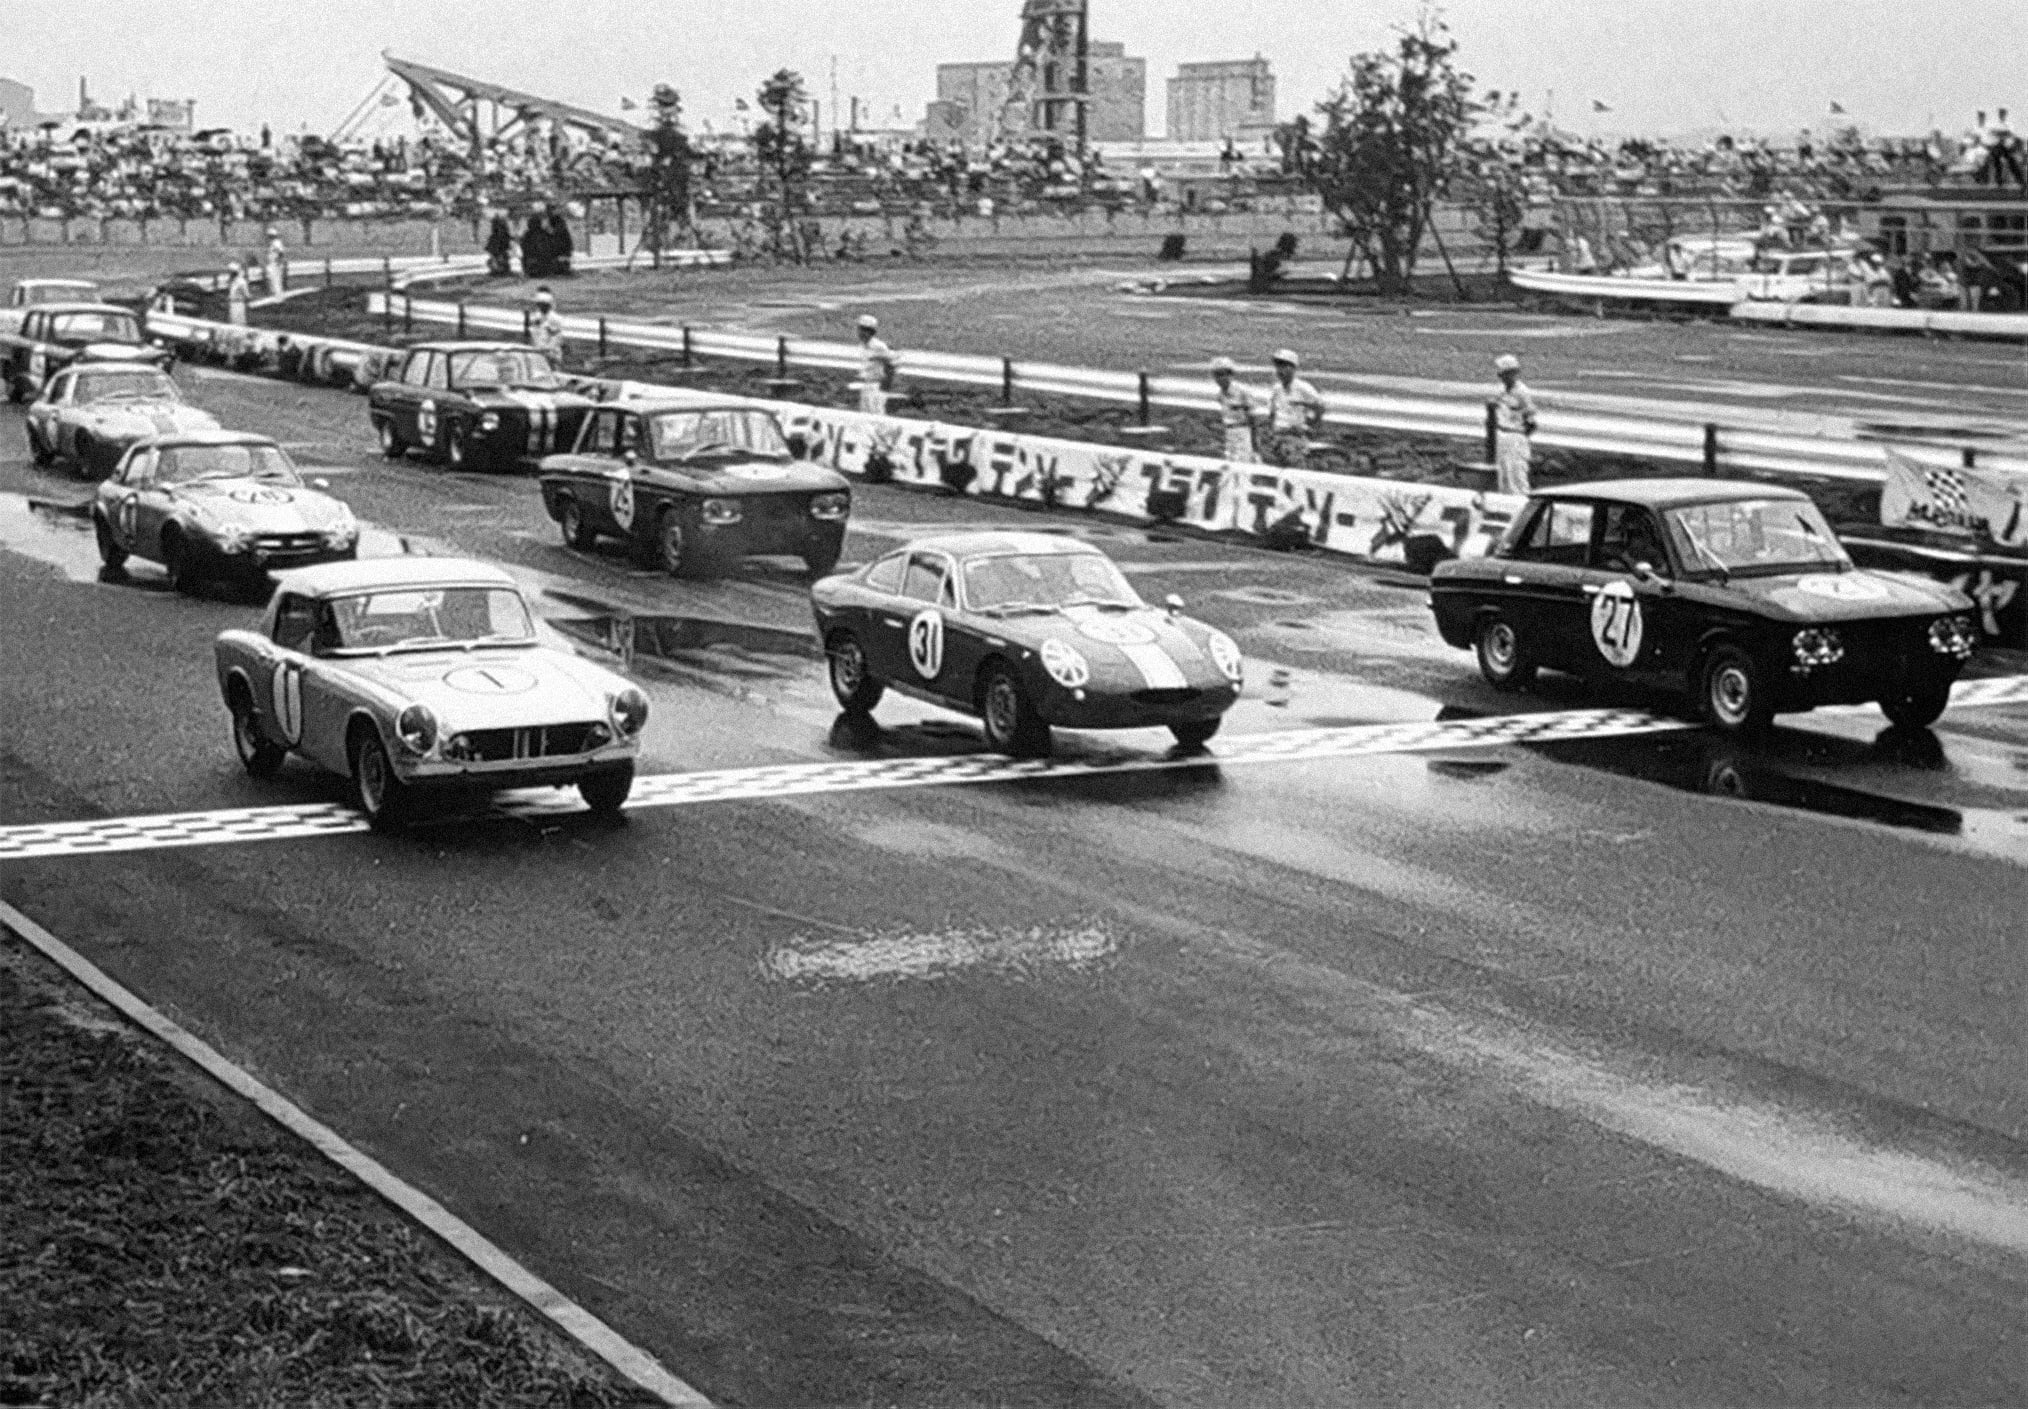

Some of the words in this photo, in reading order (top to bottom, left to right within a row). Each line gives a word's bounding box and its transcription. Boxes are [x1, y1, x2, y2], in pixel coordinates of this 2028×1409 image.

[914, 619, 939, 671] 31
[1601, 593, 1636, 650] 27
[478, 668, 506, 690] 1
